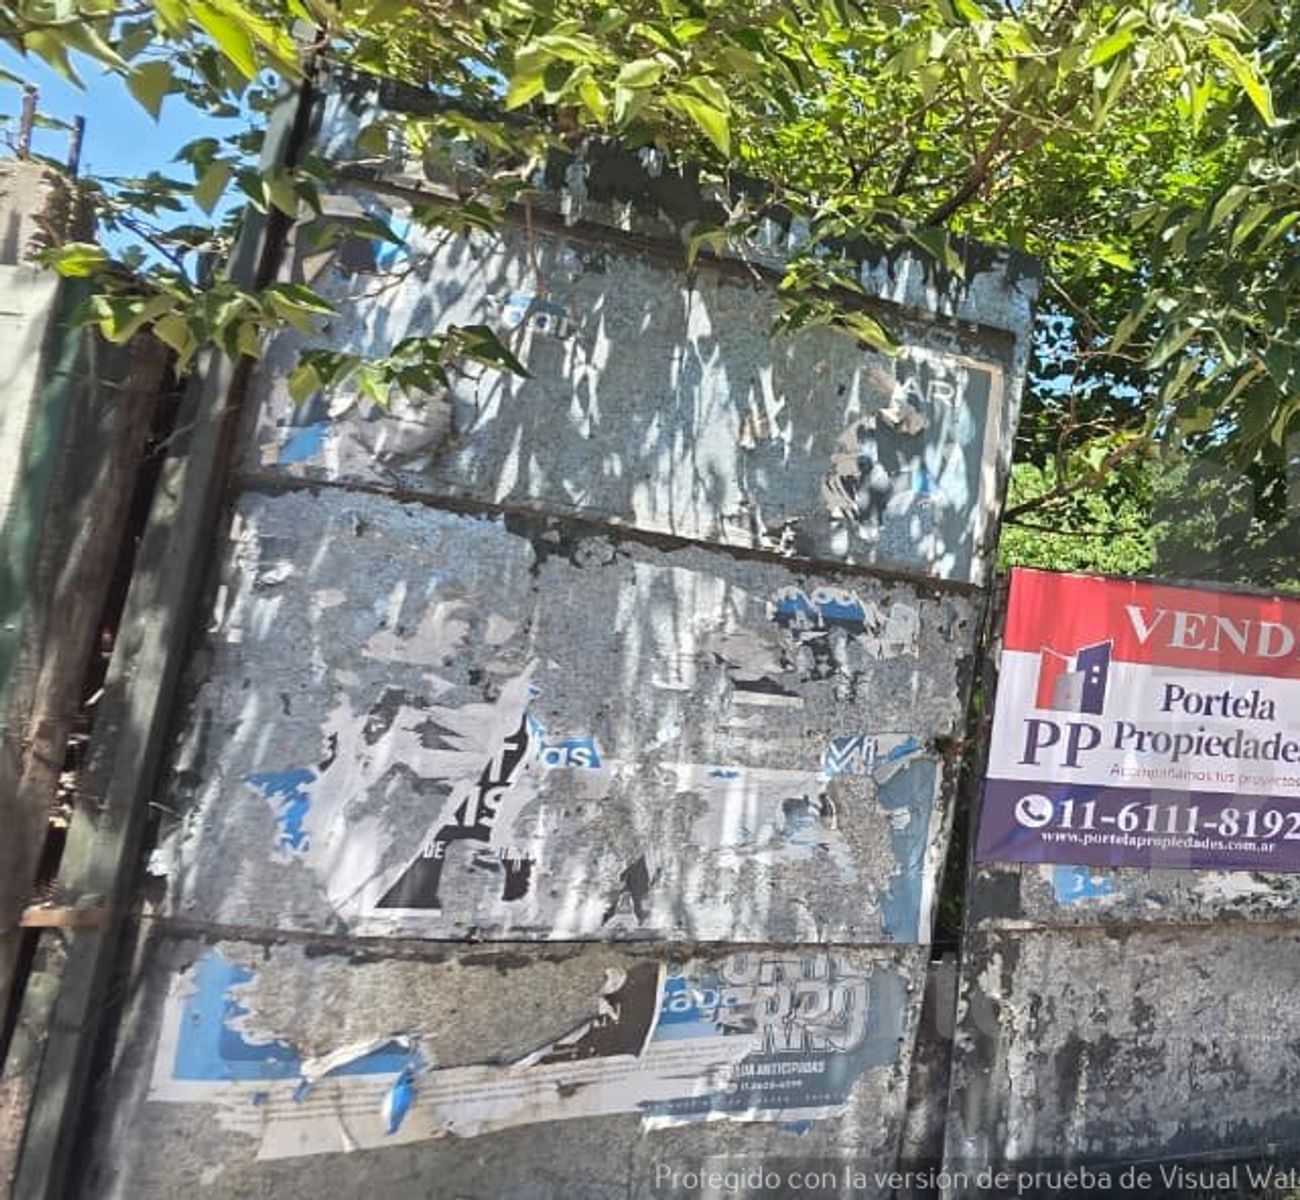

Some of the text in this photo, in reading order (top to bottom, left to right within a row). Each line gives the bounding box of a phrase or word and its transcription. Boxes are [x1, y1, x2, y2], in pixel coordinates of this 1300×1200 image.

[1160, 682, 1277, 722] Portela
[1017, 718, 1102, 769] PP
[1215, 771, 1236, 785] tus
[1040, 830, 1277, 855] www.portelapropiedades.com.ar
